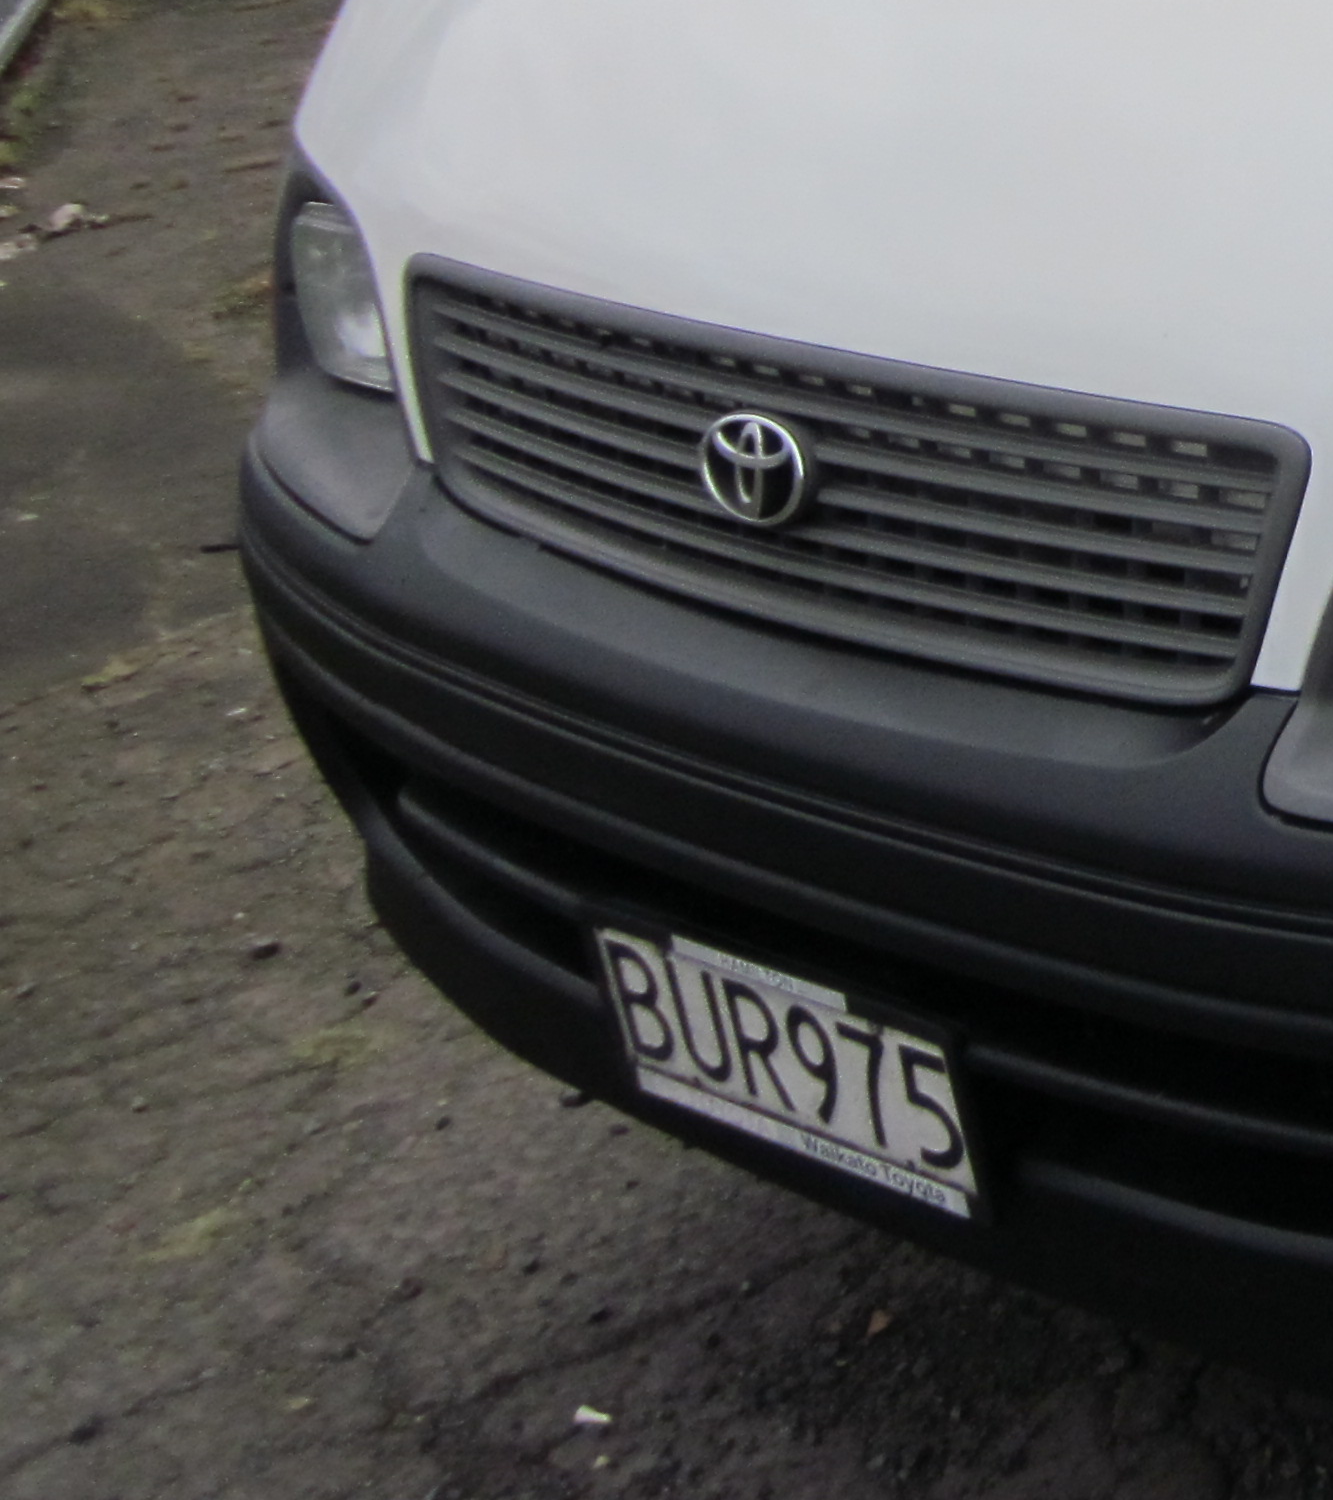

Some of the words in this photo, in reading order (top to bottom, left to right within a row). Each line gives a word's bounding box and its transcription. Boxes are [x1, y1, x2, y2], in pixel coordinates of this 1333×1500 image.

[606, 938, 966, 1169] BUR975
[802, 1134, 878, 1178] Waikato
[880, 1161, 946, 1204] Toyota
